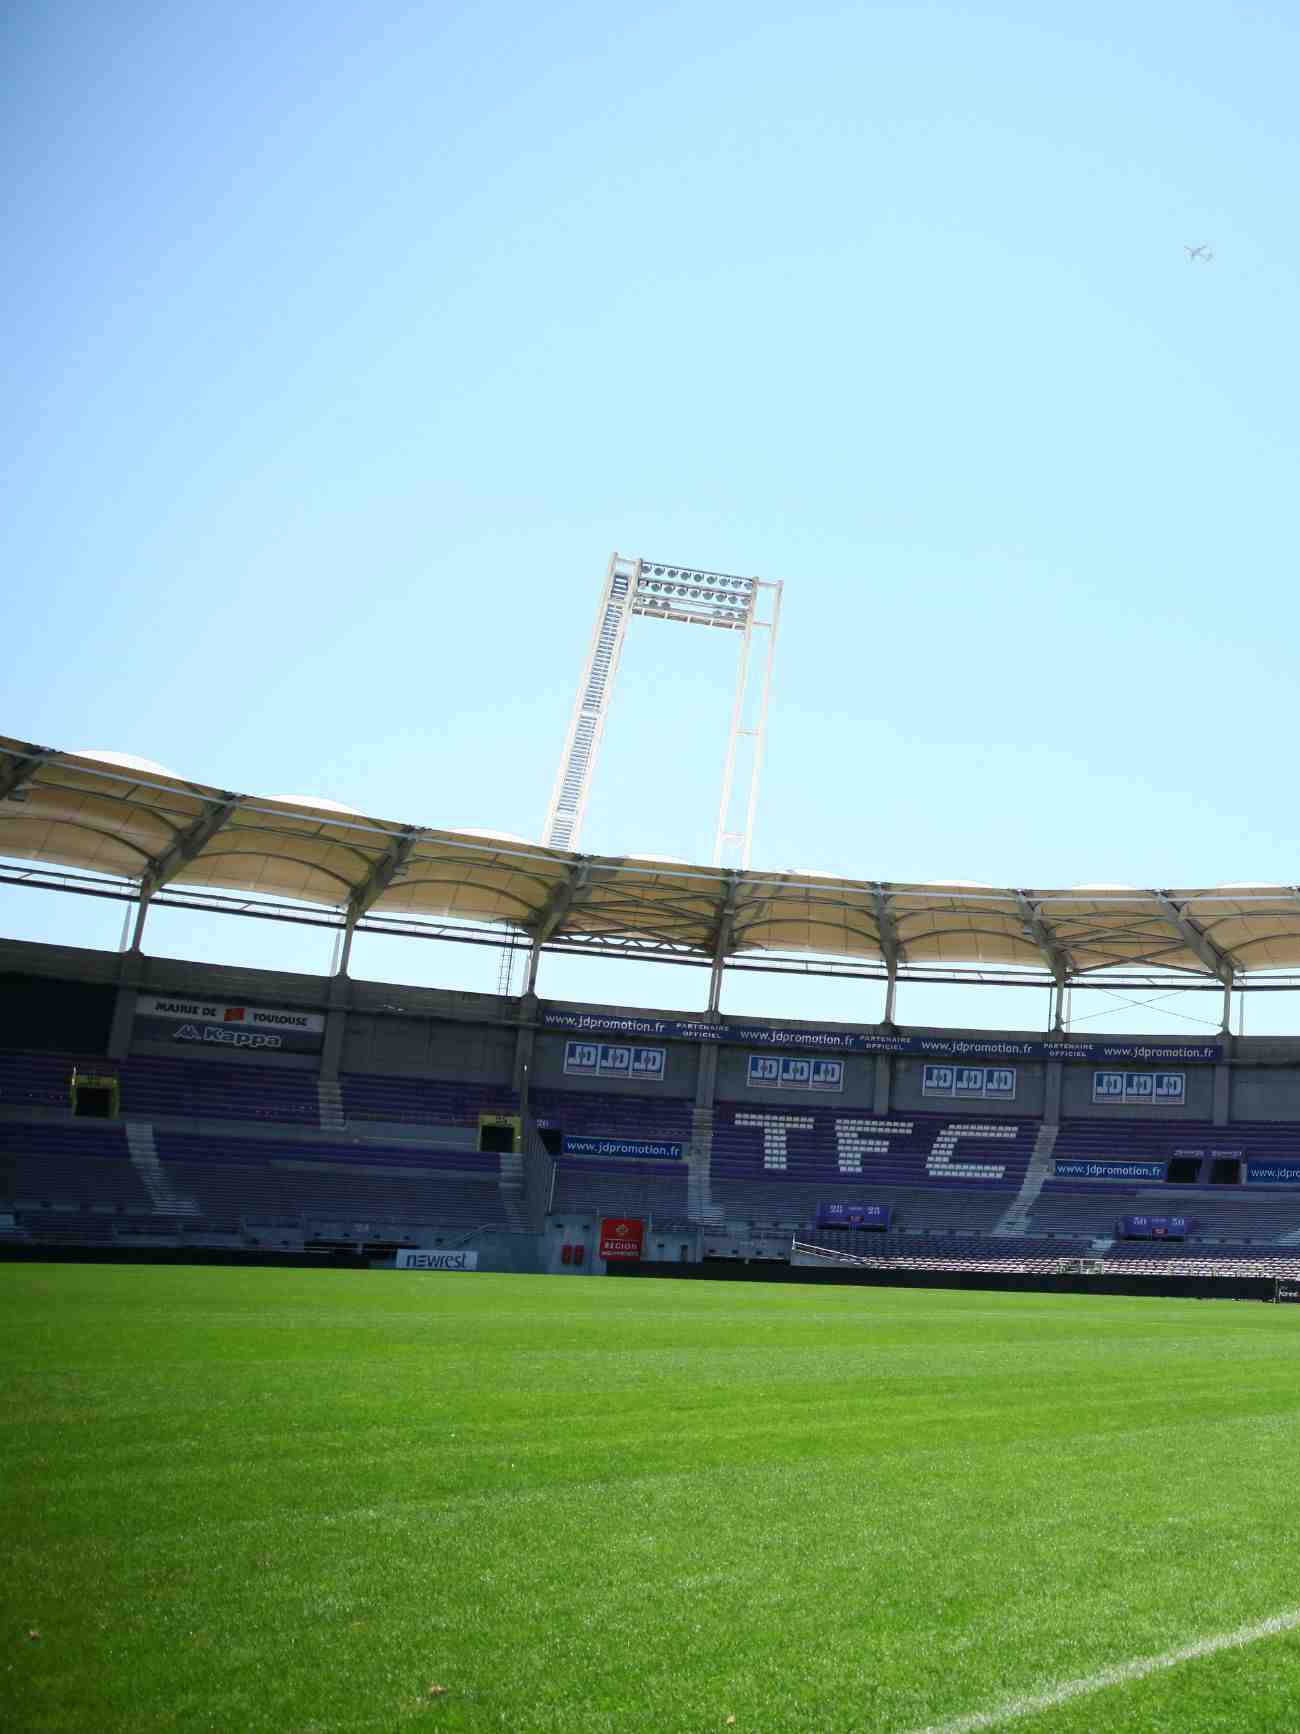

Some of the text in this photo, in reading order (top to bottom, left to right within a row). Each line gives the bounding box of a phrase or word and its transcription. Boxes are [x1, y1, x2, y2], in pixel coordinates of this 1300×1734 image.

[155, 1002, 308, 1026] MAIRIE DE TOULOUSE
[545, 1013, 665, 1034] www.jdpromotion.fr
[676, 1023, 729, 1032] PARTENAIRE
[203, 1026, 282, 1047] Kappa
[682, 1031, 721, 1039] OFFICIEL
[740, 1030, 854, 1046] www.jdpromotion.fr
[921, 1040, 1033, 1054] www.jdpromotion.fr
[1104, 1045, 1214, 1058] www.jdpromotion.fr
[567, 1142, 680, 1157] www.jdpromotion.fr
[735, 1113, 1018, 1178] TFC
[1056, 1164, 1161, 1178] www.jdpromotion.fr
